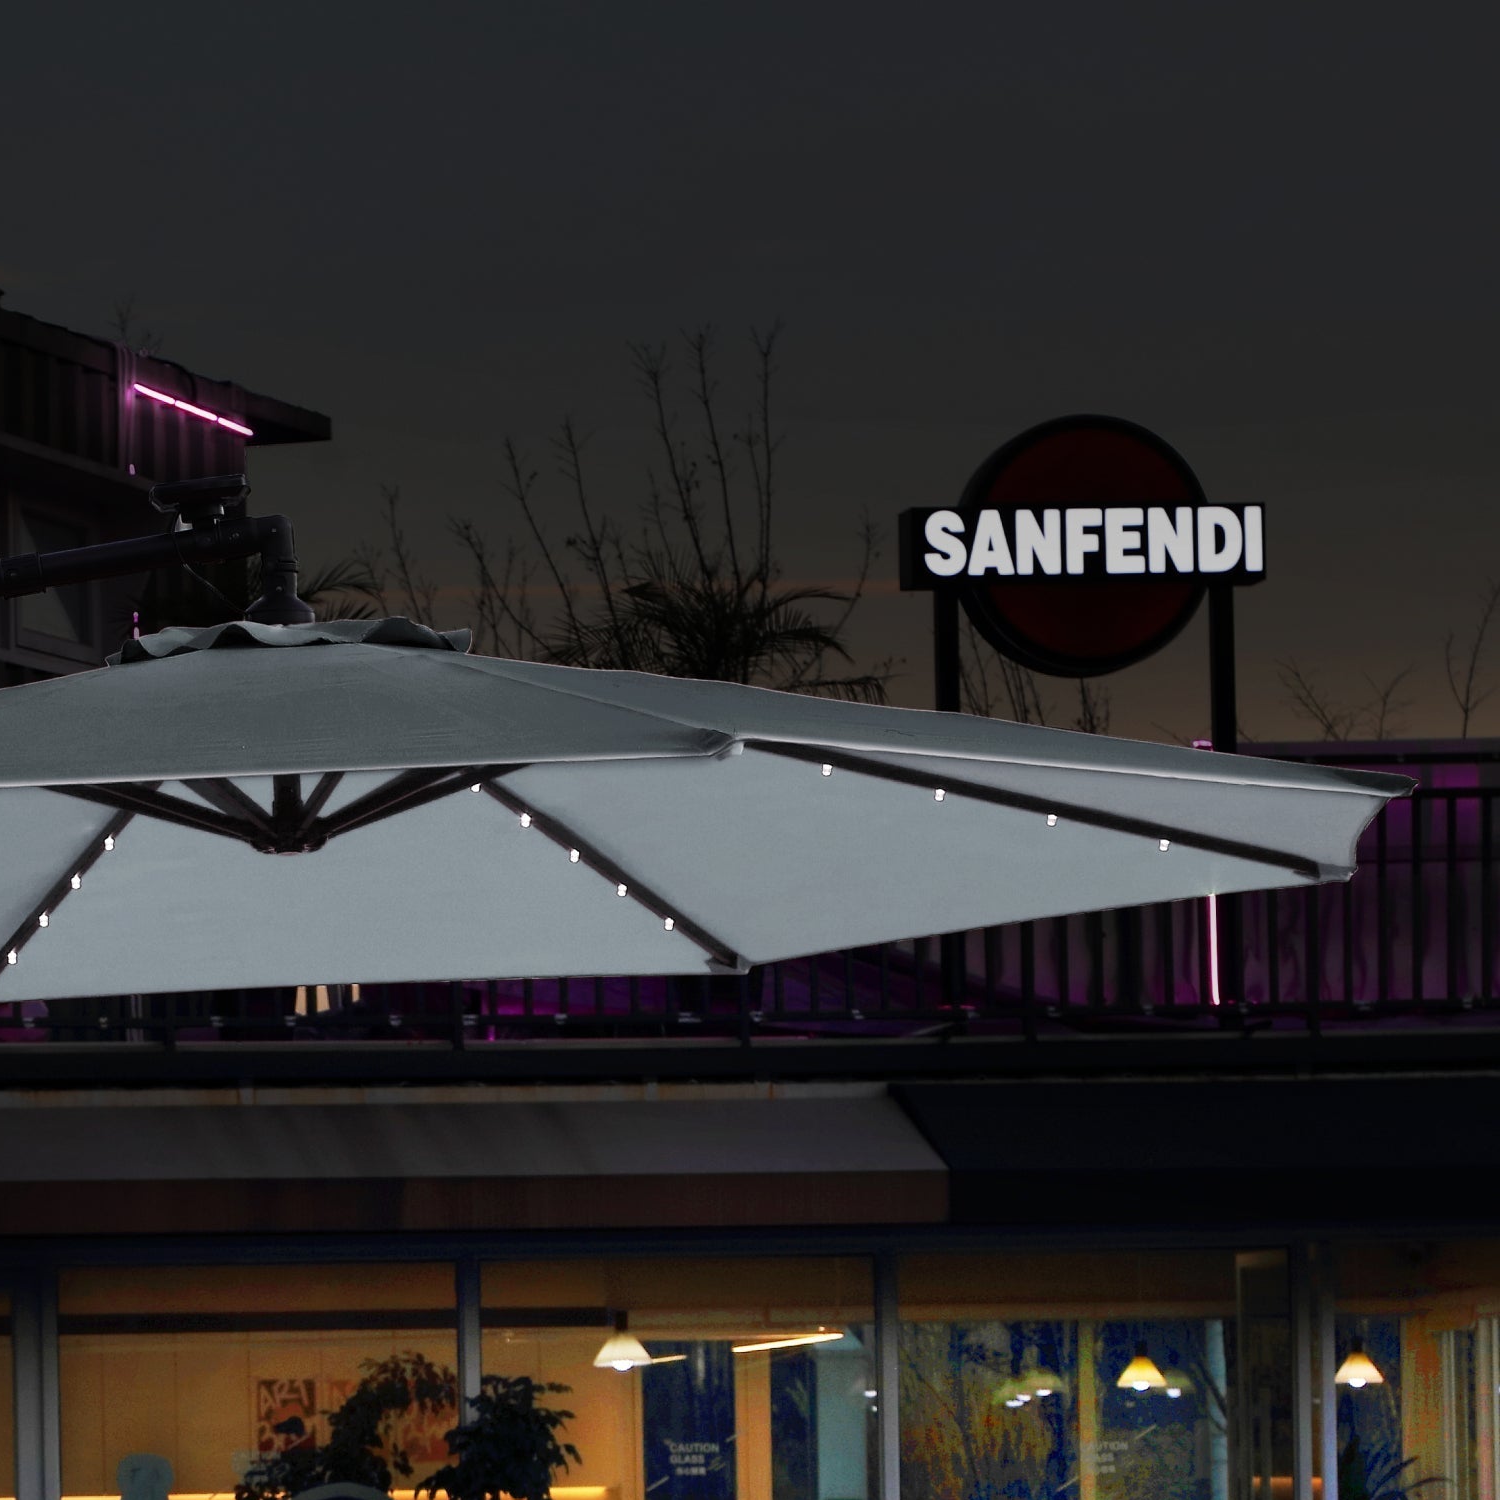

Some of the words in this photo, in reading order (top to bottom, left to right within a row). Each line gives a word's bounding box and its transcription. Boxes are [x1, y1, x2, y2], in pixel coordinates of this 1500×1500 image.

[924, 505, 1264, 576] SANFENDI
[669, 1441, 720, 1454] CAUTION
[668, 1454, 706, 1465] GLASS
